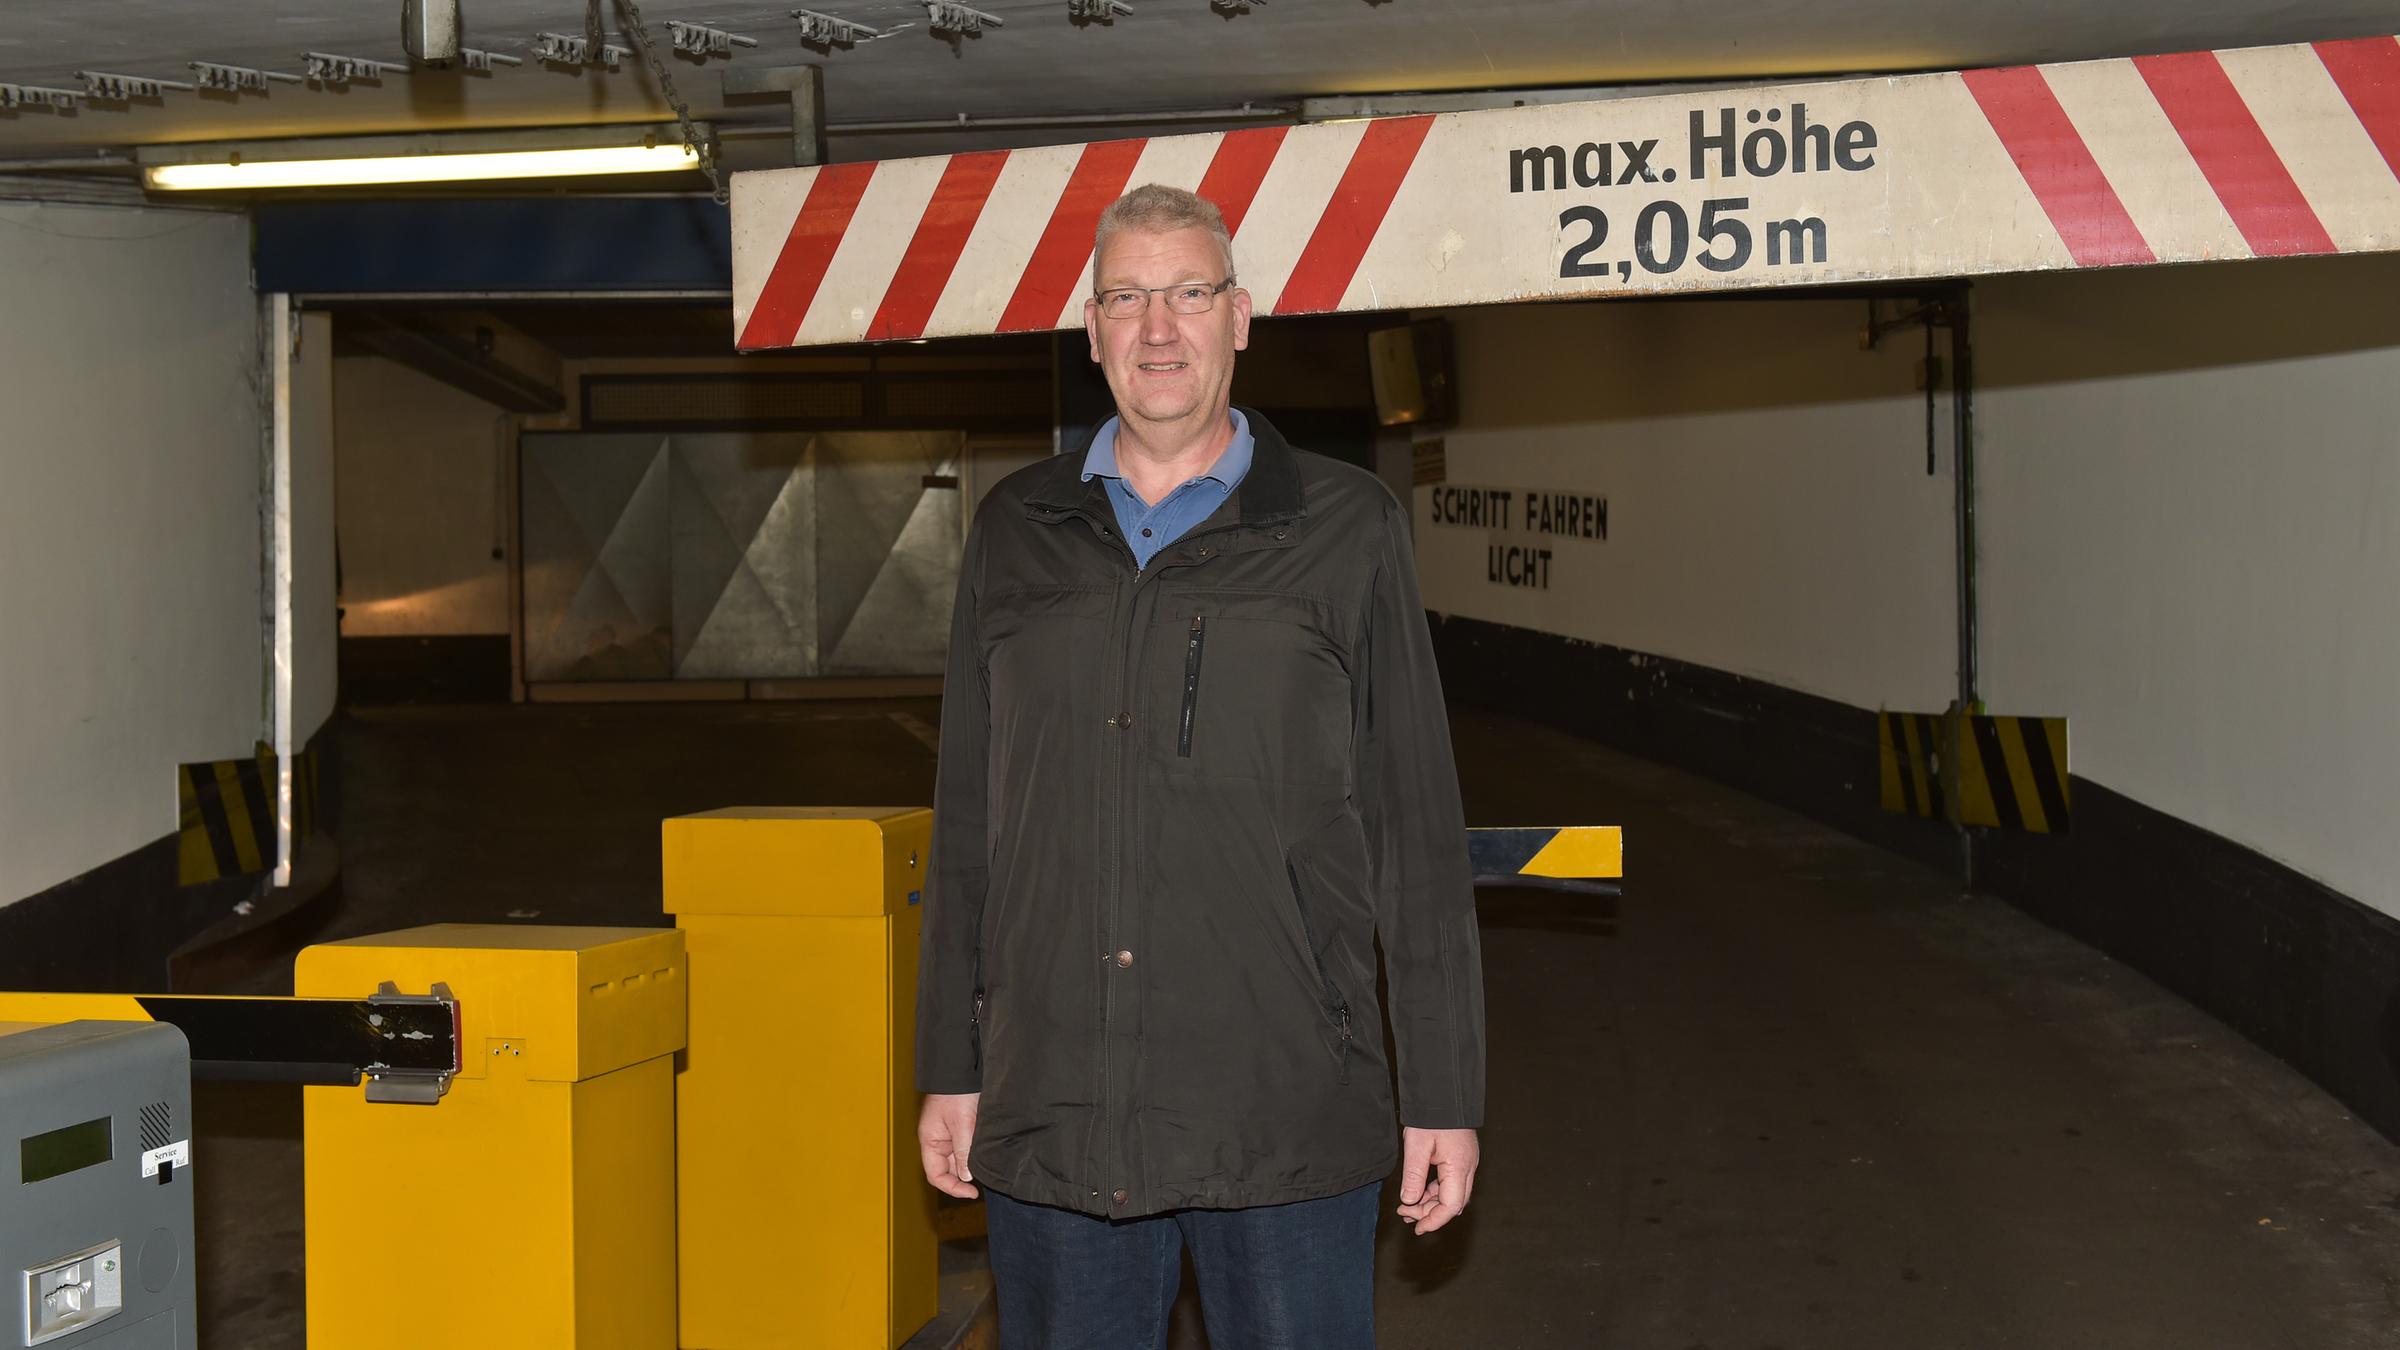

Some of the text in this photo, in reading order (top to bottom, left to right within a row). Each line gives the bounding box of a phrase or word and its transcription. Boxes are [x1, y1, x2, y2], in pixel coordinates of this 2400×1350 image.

[1509, 103, 1878, 193] max. Höhe
[1559, 197, 1753, 283] 2,05
[1432, 487, 1608, 541] SCHRITT FAHREN
[1488, 546, 1553, 589] LICHT
[154, 1149, 177, 1160] Service
